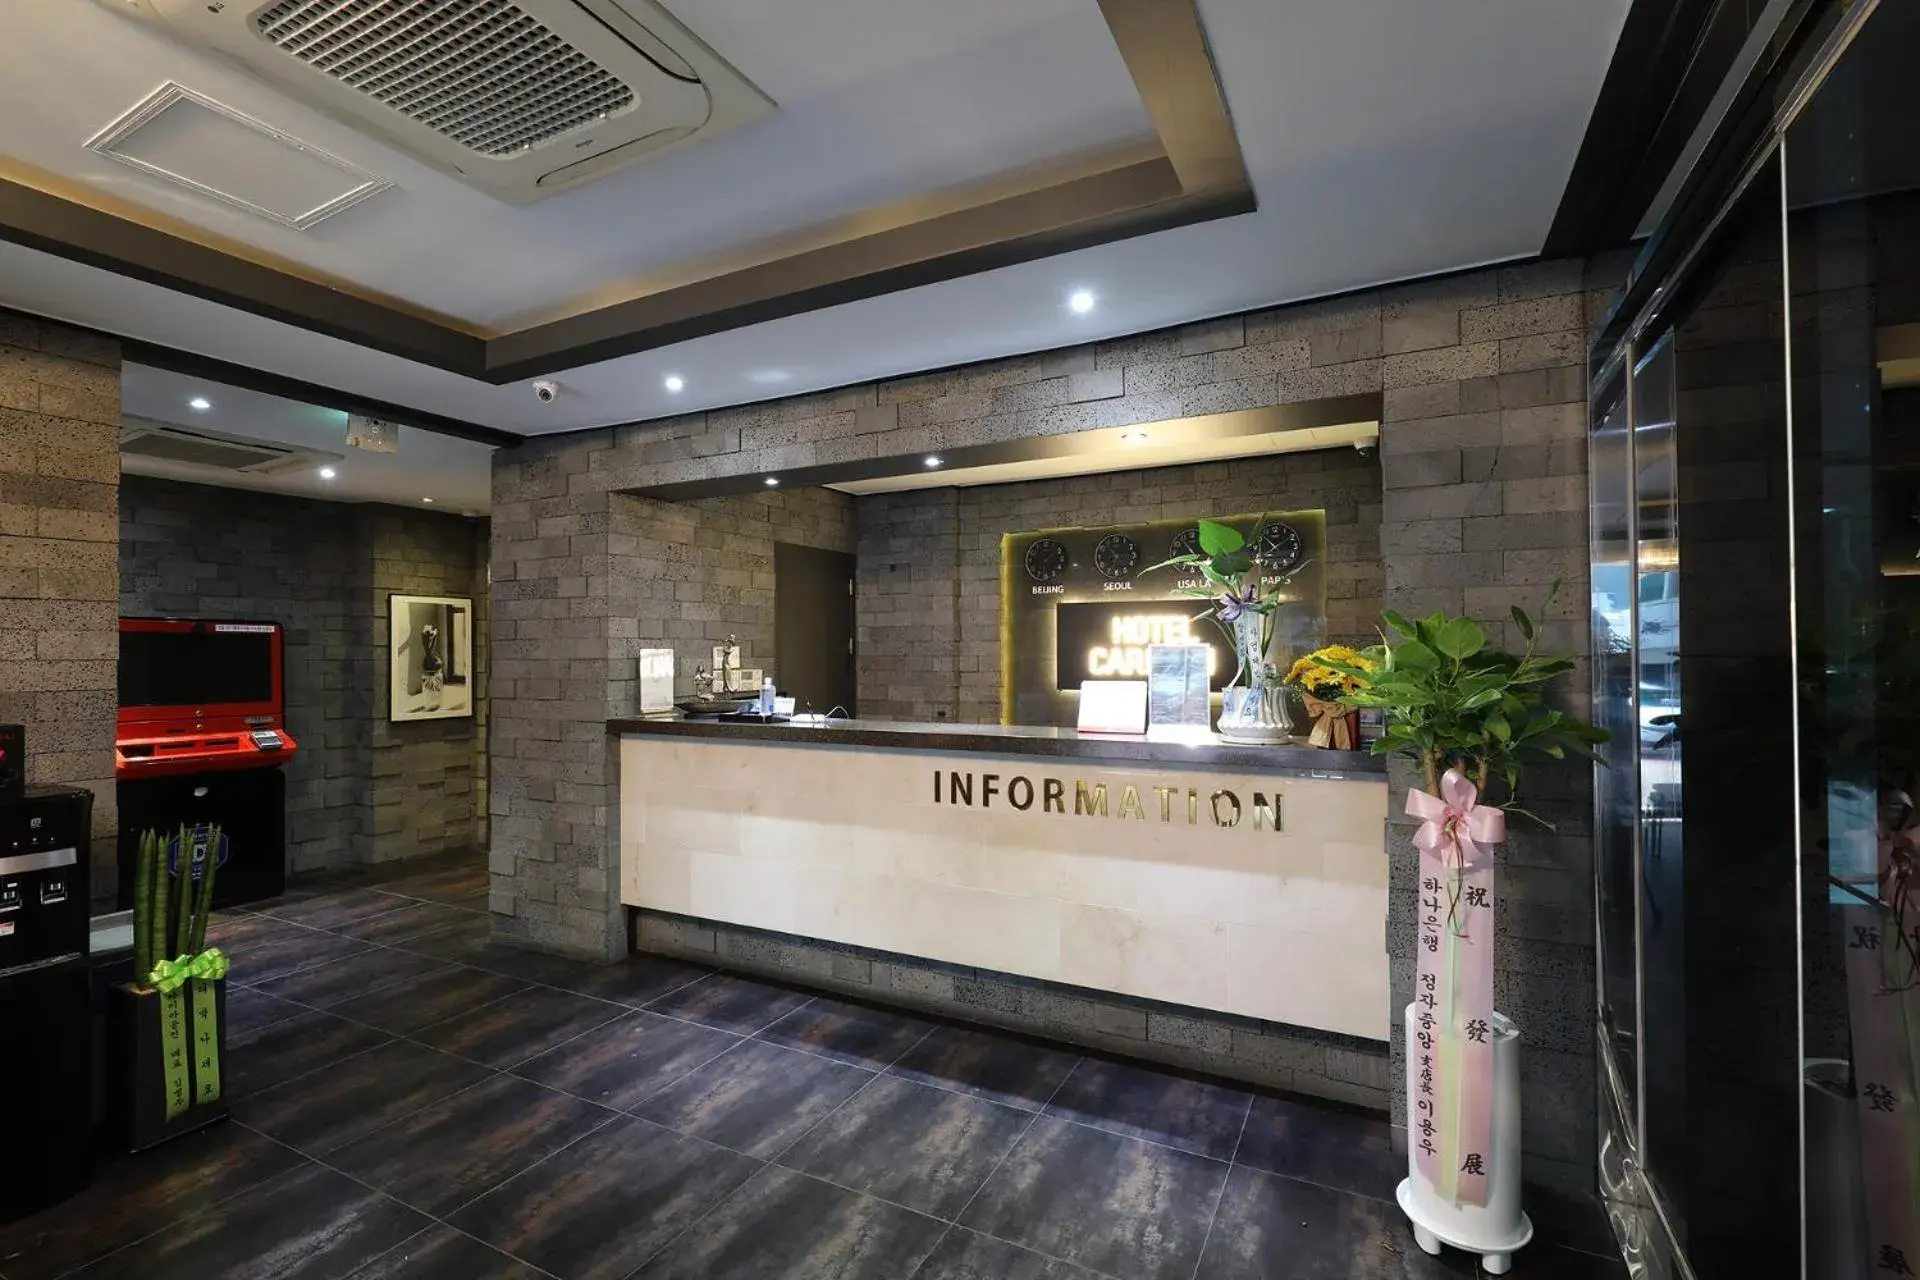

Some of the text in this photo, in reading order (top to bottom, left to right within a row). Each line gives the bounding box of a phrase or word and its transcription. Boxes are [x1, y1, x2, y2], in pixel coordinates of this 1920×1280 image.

[1032, 585, 1064, 594] BEIJING
[1104, 581, 1133, 591] SEOUL
[1177, 579, 1212, 589] USA LA
[1111, 615, 1200, 644] HOTEL
[933, 770, 1285, 832] INFORMATION
[1422, 877, 1443, 952] 하나은행
